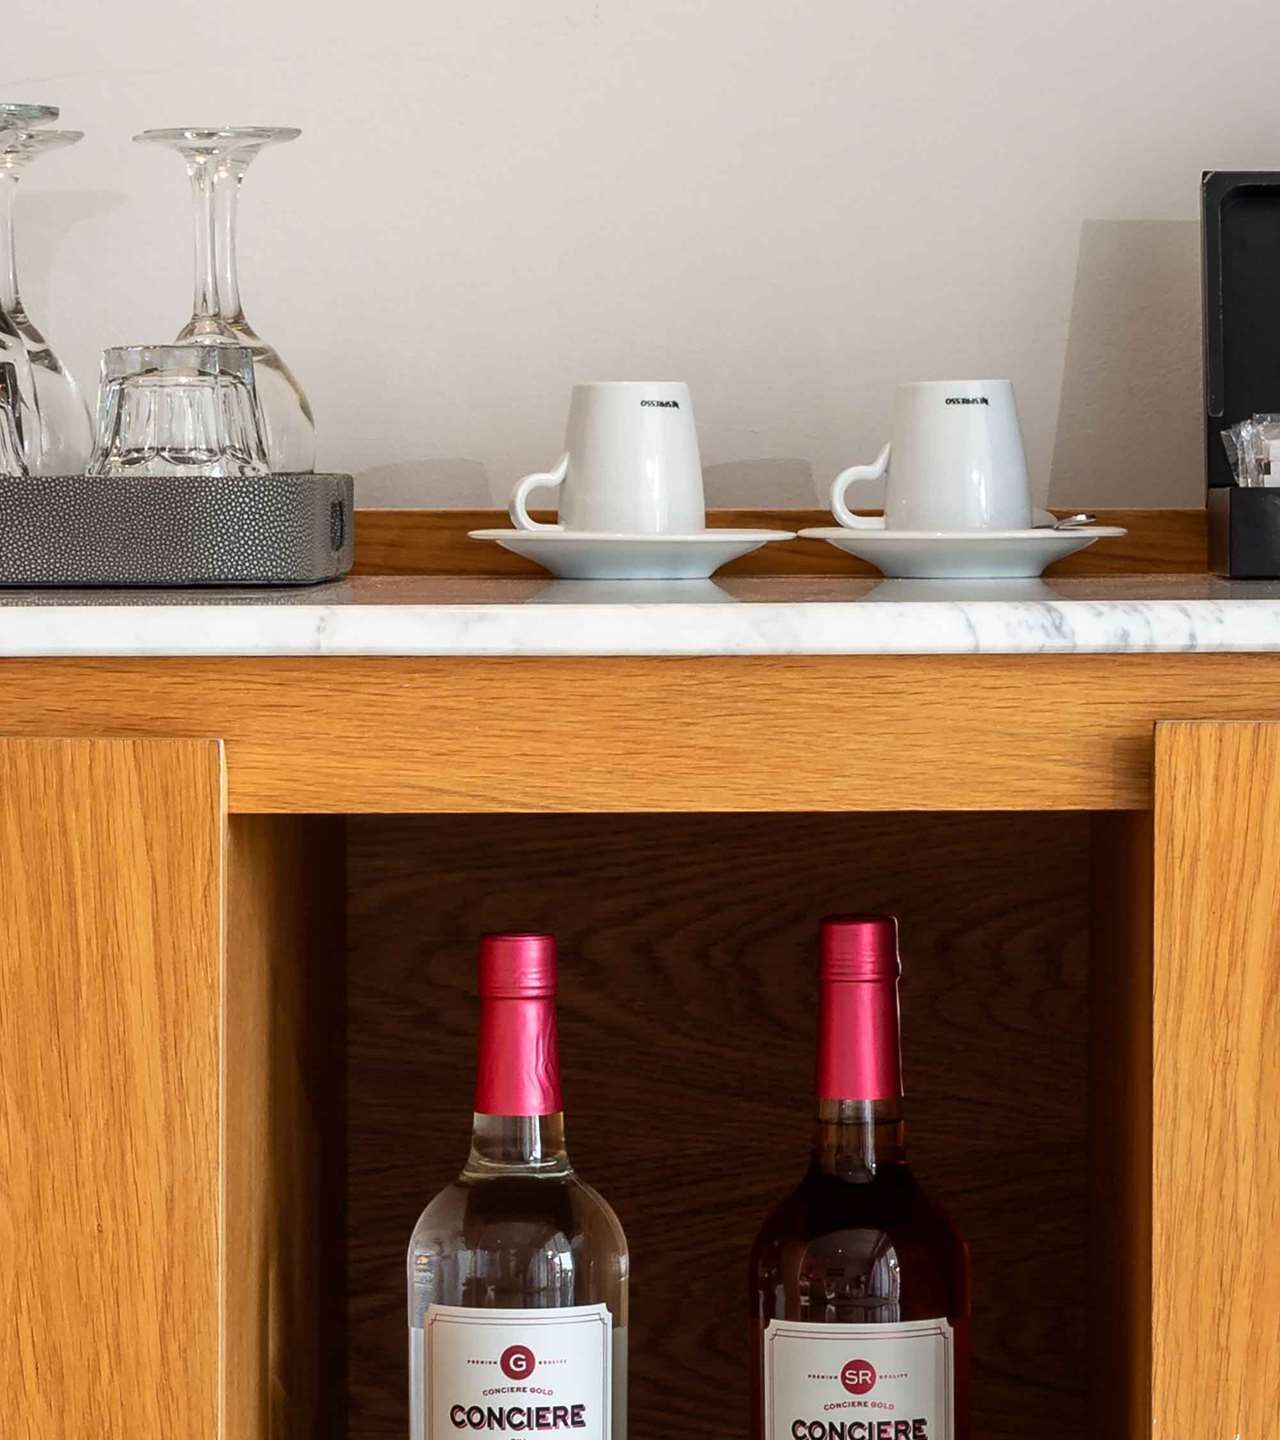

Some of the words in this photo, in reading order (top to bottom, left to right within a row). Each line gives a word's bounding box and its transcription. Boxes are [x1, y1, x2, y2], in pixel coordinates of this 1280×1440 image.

[509, 1354, 527, 1372] G
[845, 1370, 872, 1385] SR
[483, 1387, 527, 1396] CONCIERE
[530, 1387, 553, 1396] GOLD
[824, 1401, 868, 1411] CONCIERE
[871, 1401, 895, 1410] GOLD
[450, 1404, 586, 1431] CONCIERE
